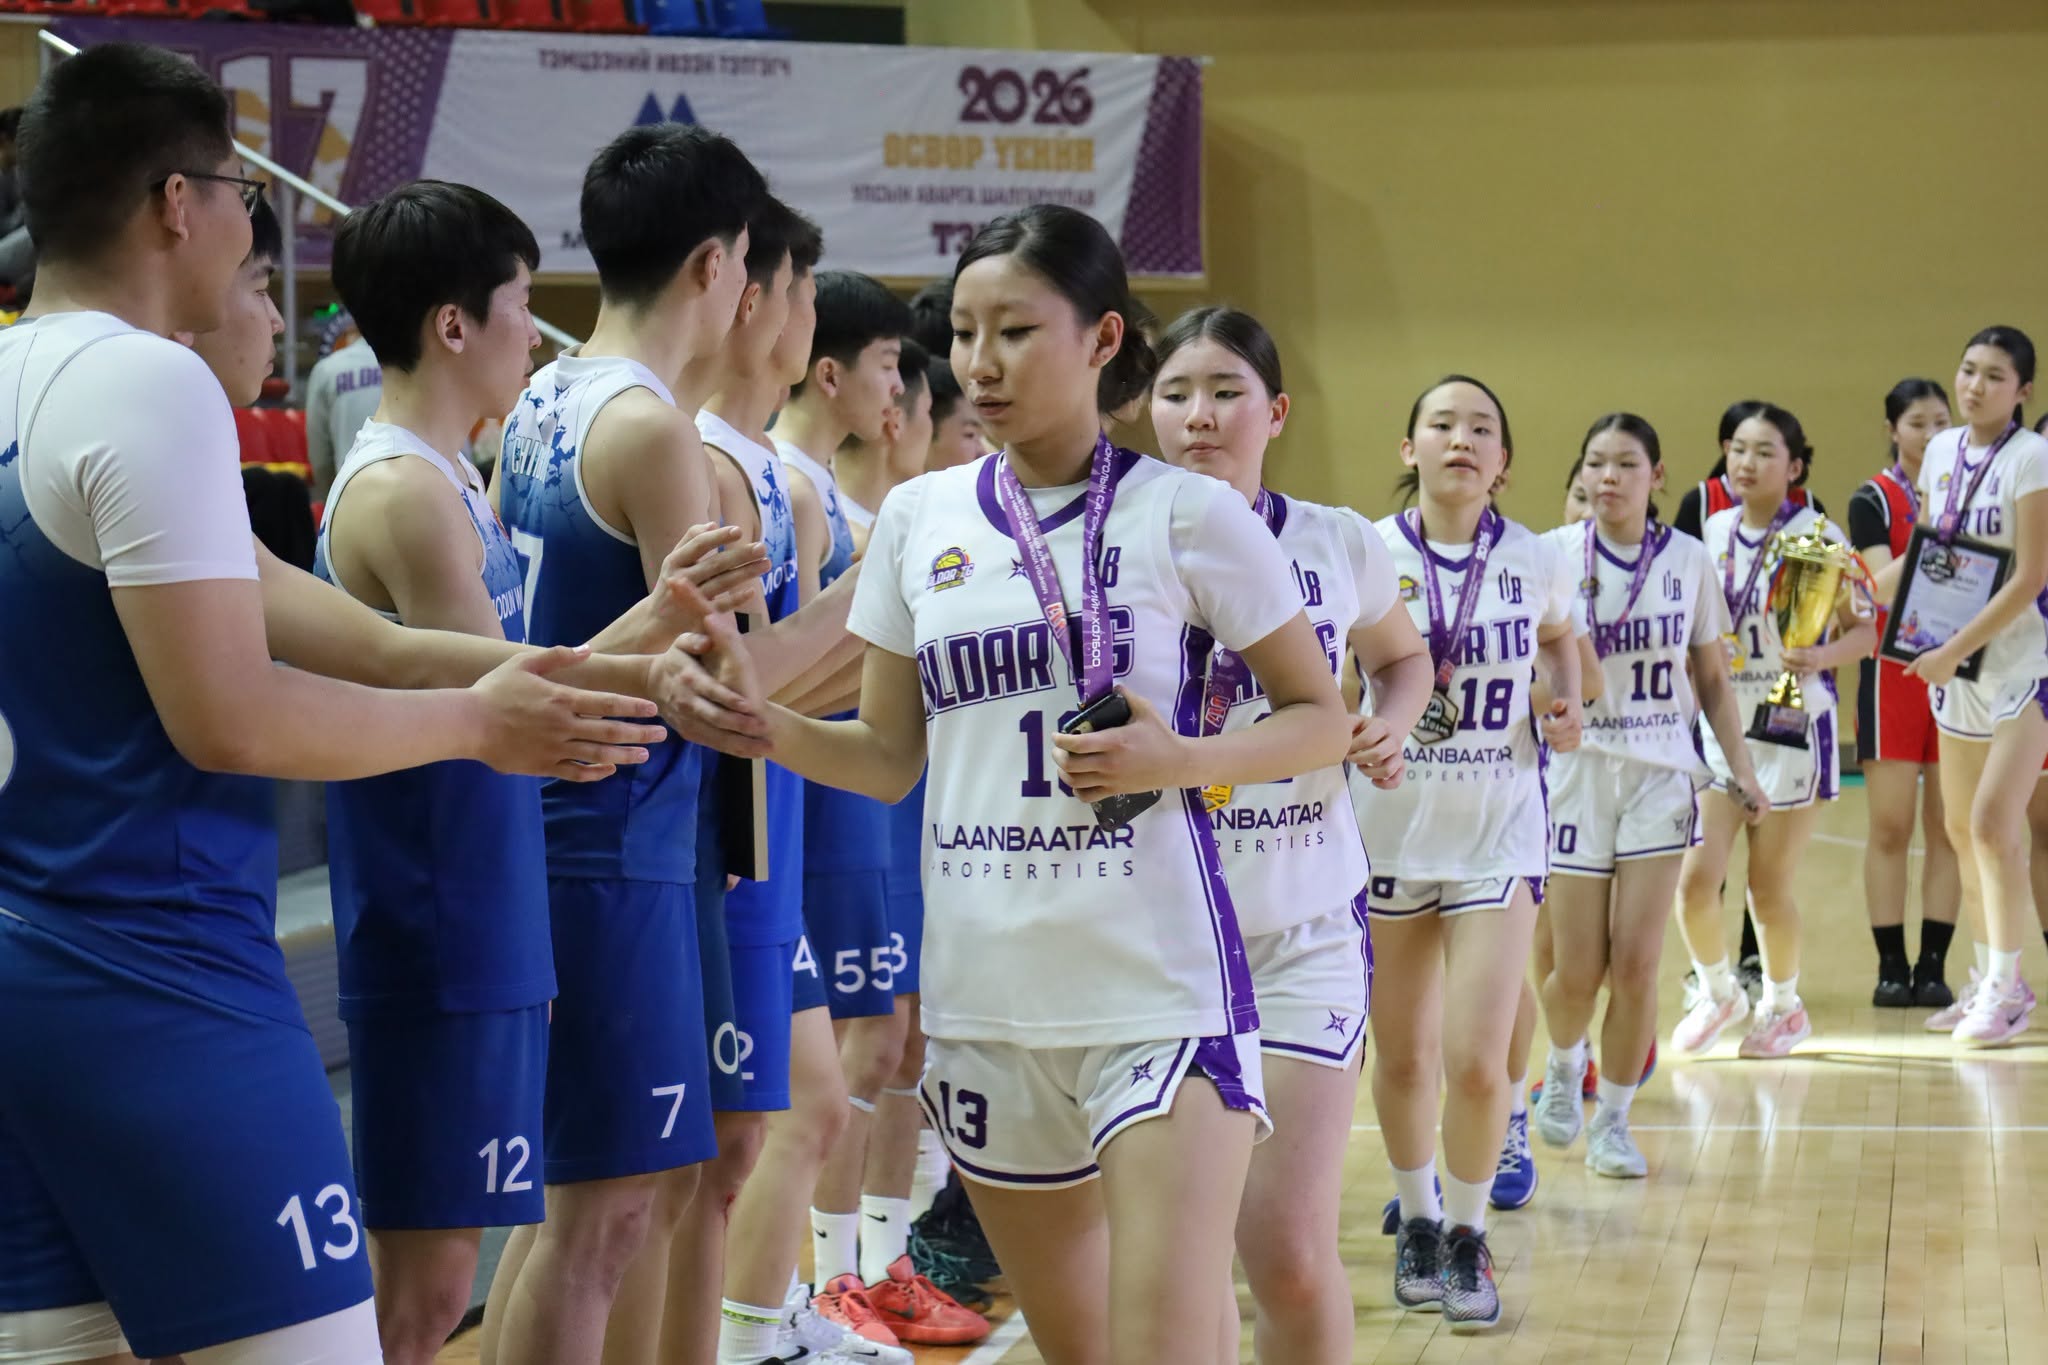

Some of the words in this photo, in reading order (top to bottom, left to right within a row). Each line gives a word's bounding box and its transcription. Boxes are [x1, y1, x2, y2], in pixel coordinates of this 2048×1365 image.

[958, 65, 1093, 125] 2026
[221, 55, 367, 224] 17
[336, 367, 382, 393] ALDA
[511, 526, 545, 645] 7
[1091, 617, 1101, 668] ХОЛБОО
[1312, 618, 1338, 677] G
[1491, 616, 1531, 664] TG
[1657, 612, 1685, 648] TG
[1748, 624, 1764, 659] 1
[1458, 677, 1514, 731] 18
[1631, 660, 1673, 701] 10
[1403, 745, 1512, 764] AANBAATAR
[1407, 768, 1514, 782] OPERTIES
[1208, 801, 1323, 830] NBAATAR
[931, 860, 1134, 880] ROPERTIES
[792, 935, 818, 978] 4
[834, 948, 893, 993] 55
[889, 932, 908, 974] 3
[713, 1021, 740, 1075] 0
[651, 1083, 686, 1139] 7
[938, 1080, 988, 1150] 13
[478, 1135, 533, 1193] 12
[276, 1183, 359, 1271] 13
